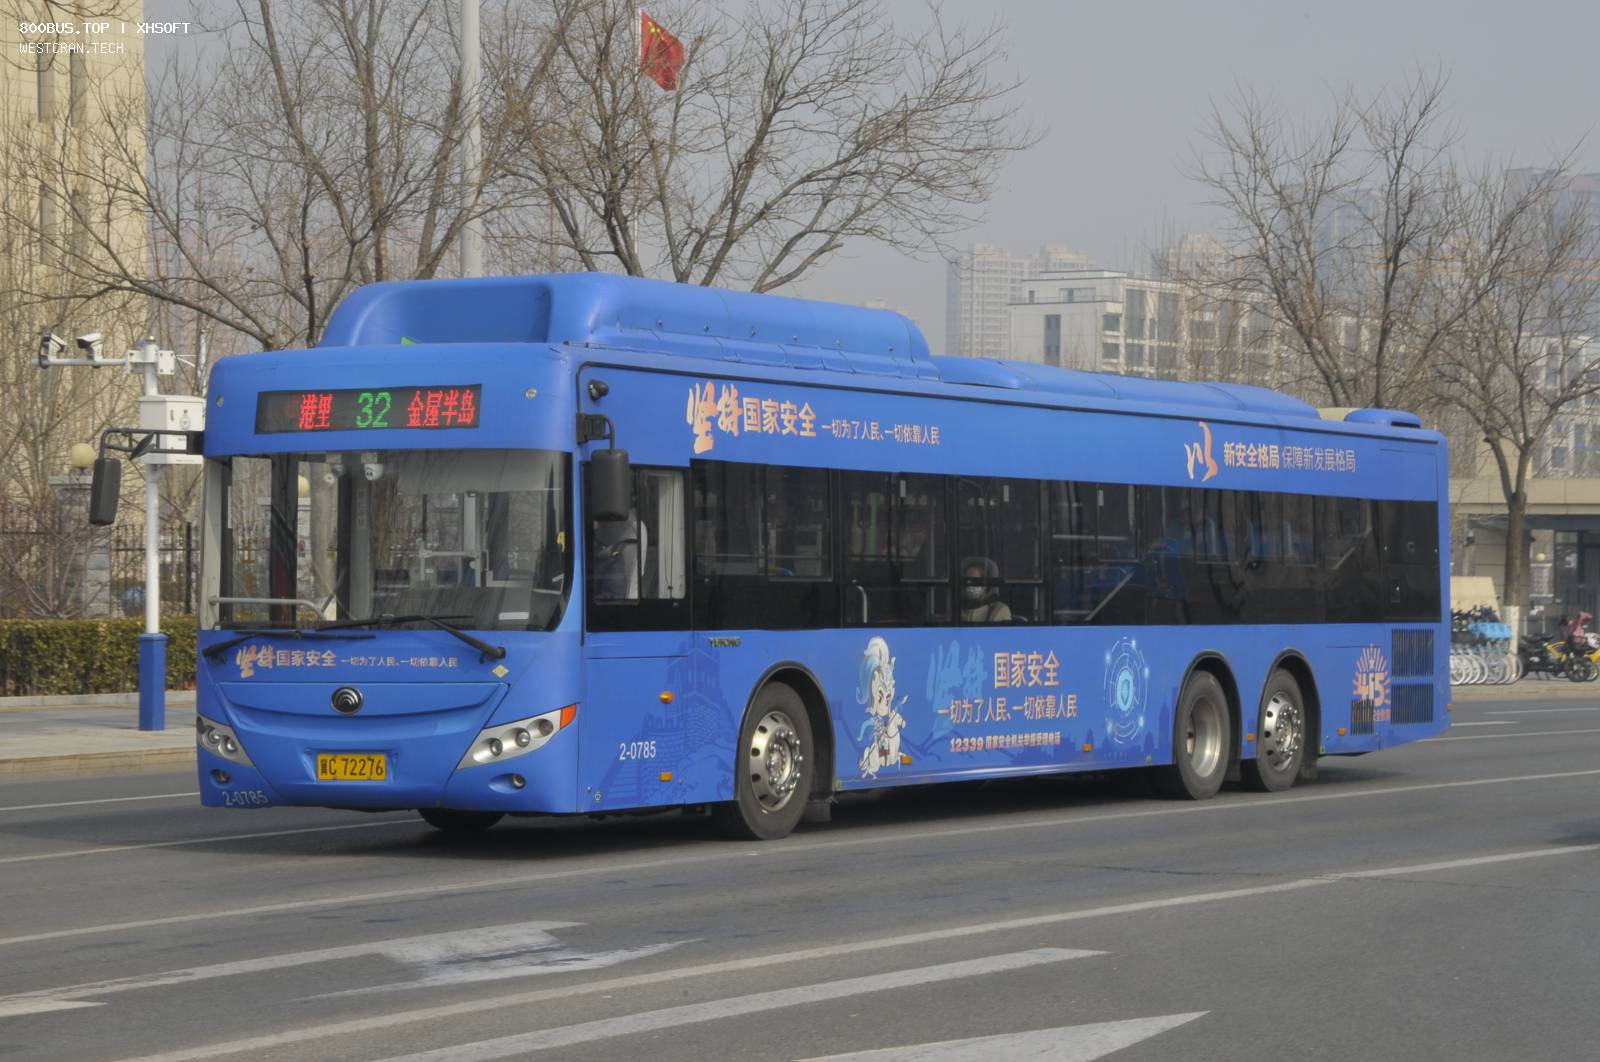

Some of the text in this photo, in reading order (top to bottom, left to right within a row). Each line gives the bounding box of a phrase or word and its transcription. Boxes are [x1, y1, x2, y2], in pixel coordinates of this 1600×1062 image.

[356, 392, 392, 428] 32
[687, 381, 817, 455] 坚持国家安全
[1282, 446, 1356, 473] 保障新发展格局
[993, 650, 1061, 689] 国家安全
[937, 694, 1078, 725] 一切为了人民、一切依靠人民
[619, 740, 657, 760] 2-0785
[950, 737, 984, 752] 12339
[222, 790, 269, 807] 2-0785
